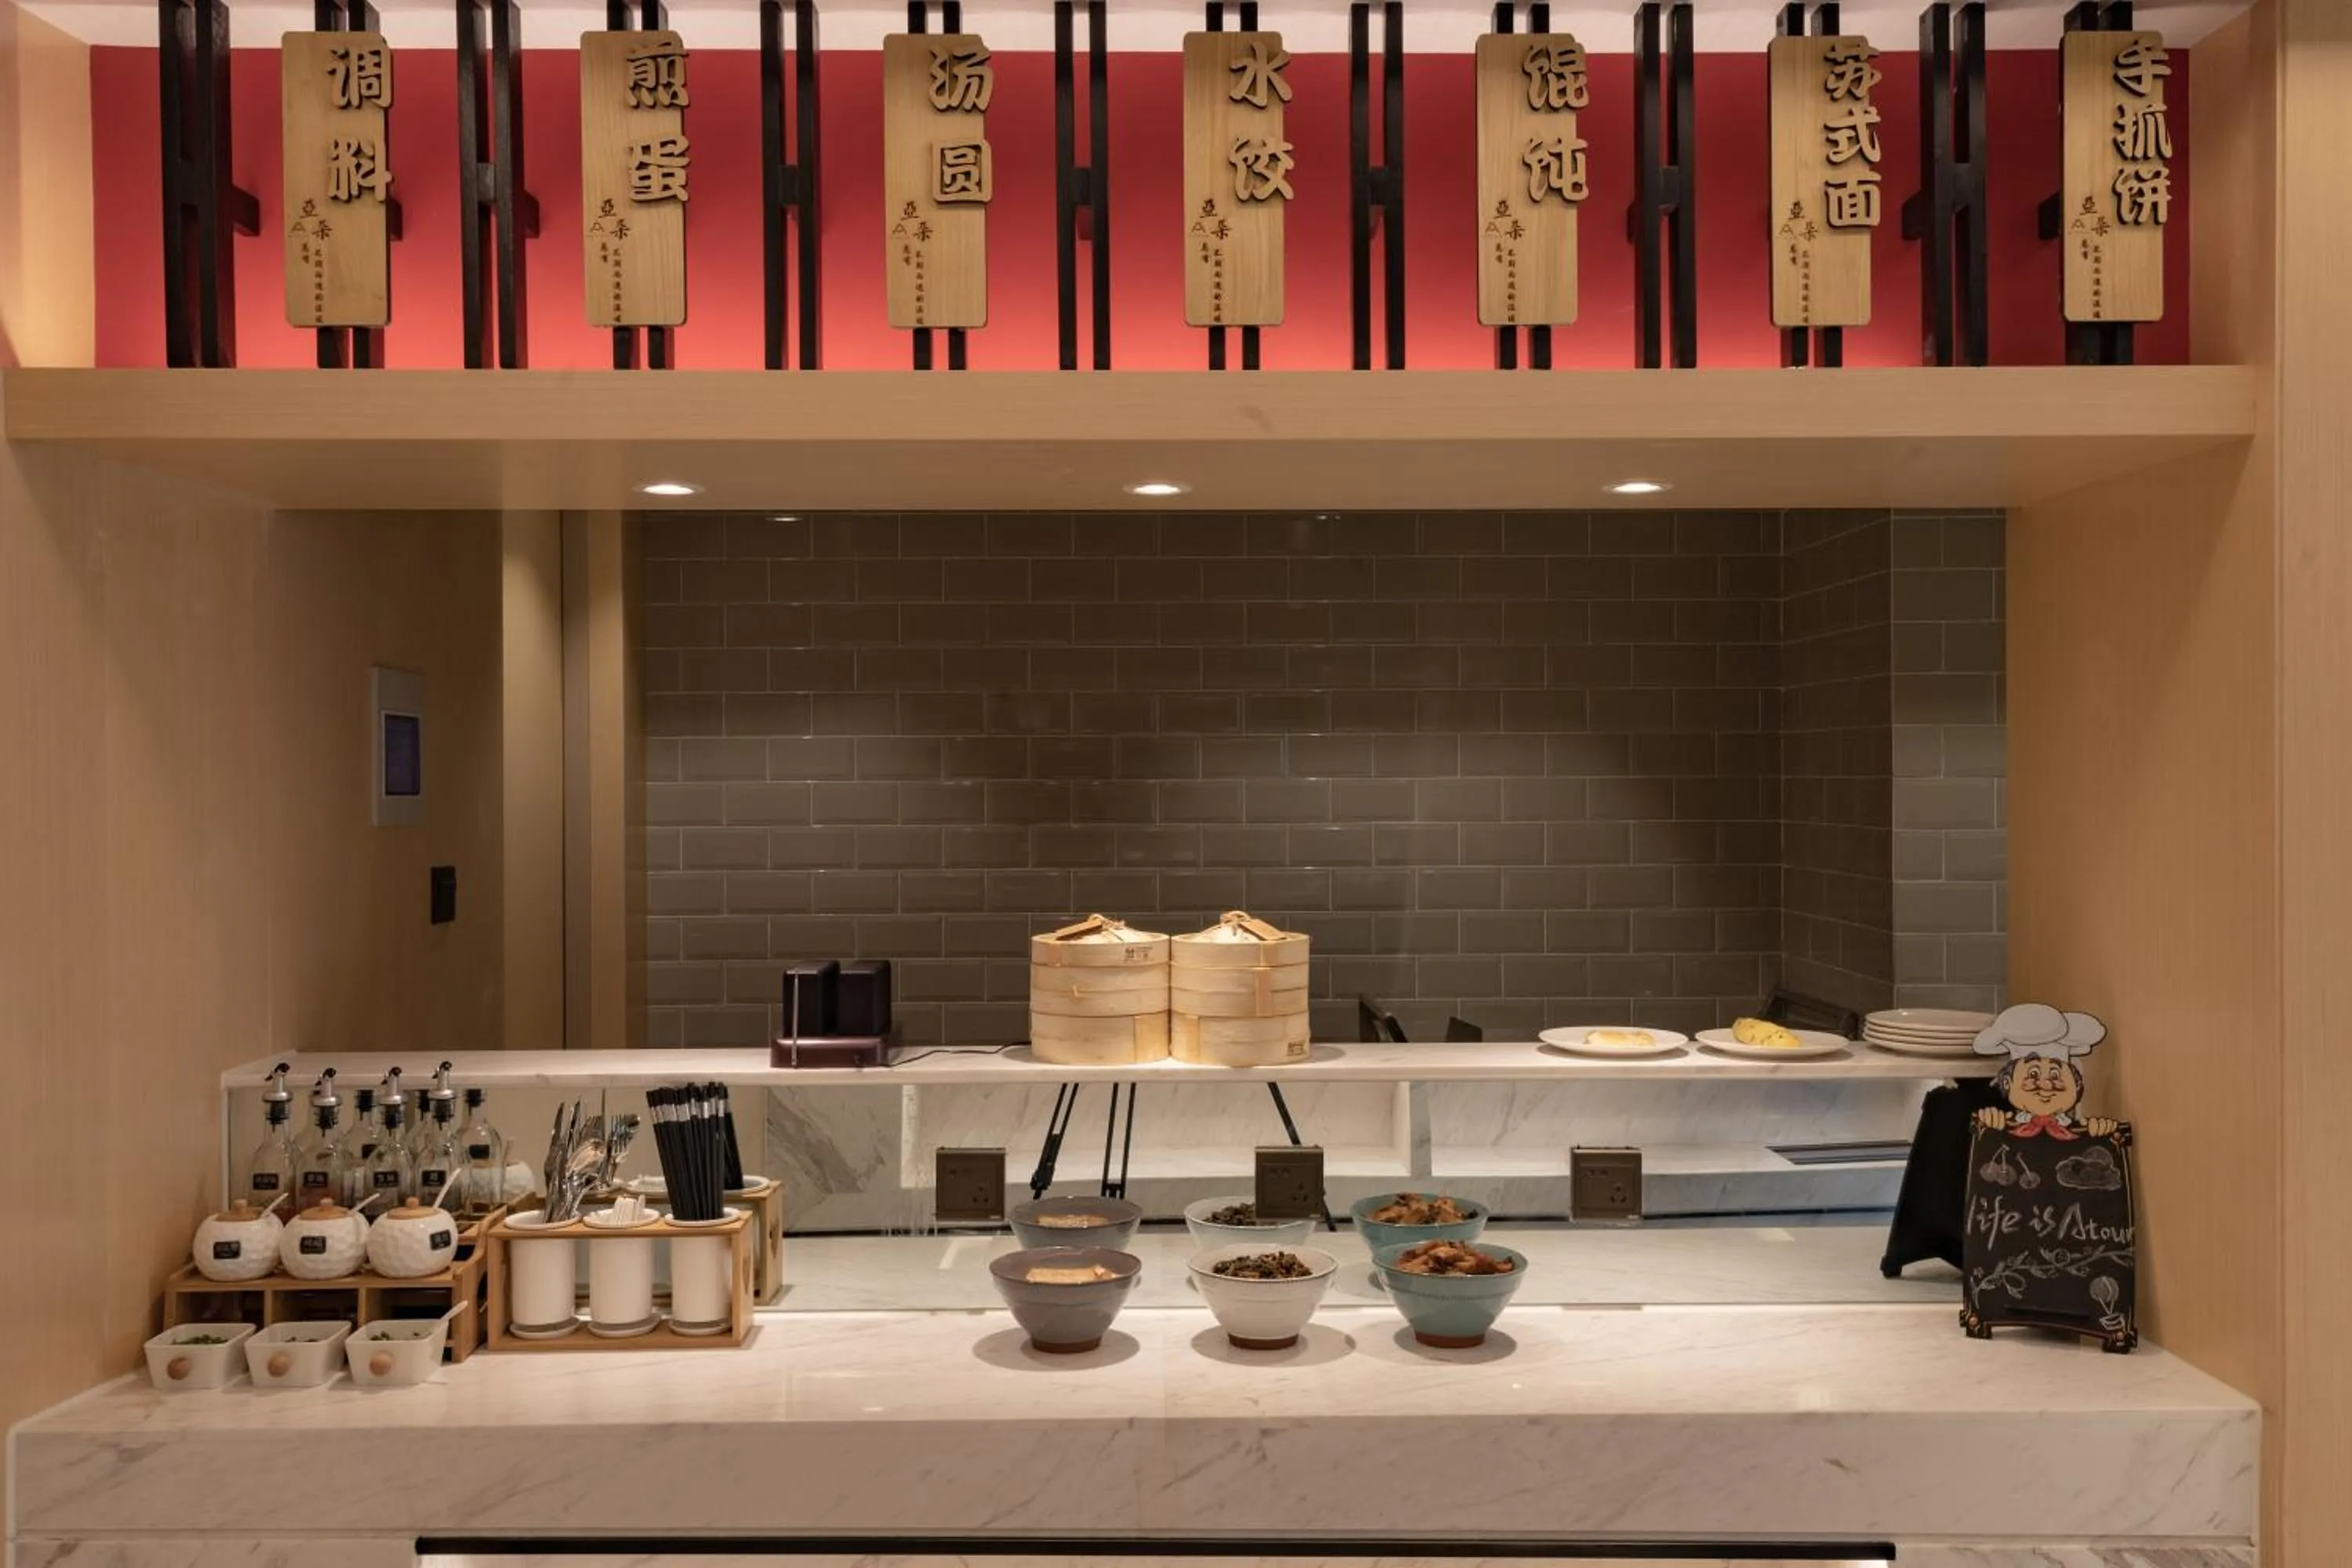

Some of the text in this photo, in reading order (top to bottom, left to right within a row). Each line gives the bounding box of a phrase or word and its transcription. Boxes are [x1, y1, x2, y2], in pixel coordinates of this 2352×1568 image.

[328, 48, 393, 201] 调料
[627, 42, 690, 202] 煎蛋
[930, 45, 994, 202] 汤圆
[1229, 42, 1294, 201] 水饺
[1523, 42, 1589, 201] 馄饨
[1824, 43, 1881, 227] 苏式面
[2114, 40, 2172, 225] 手抓饼
[2028, 1203, 2058, 1236] is
